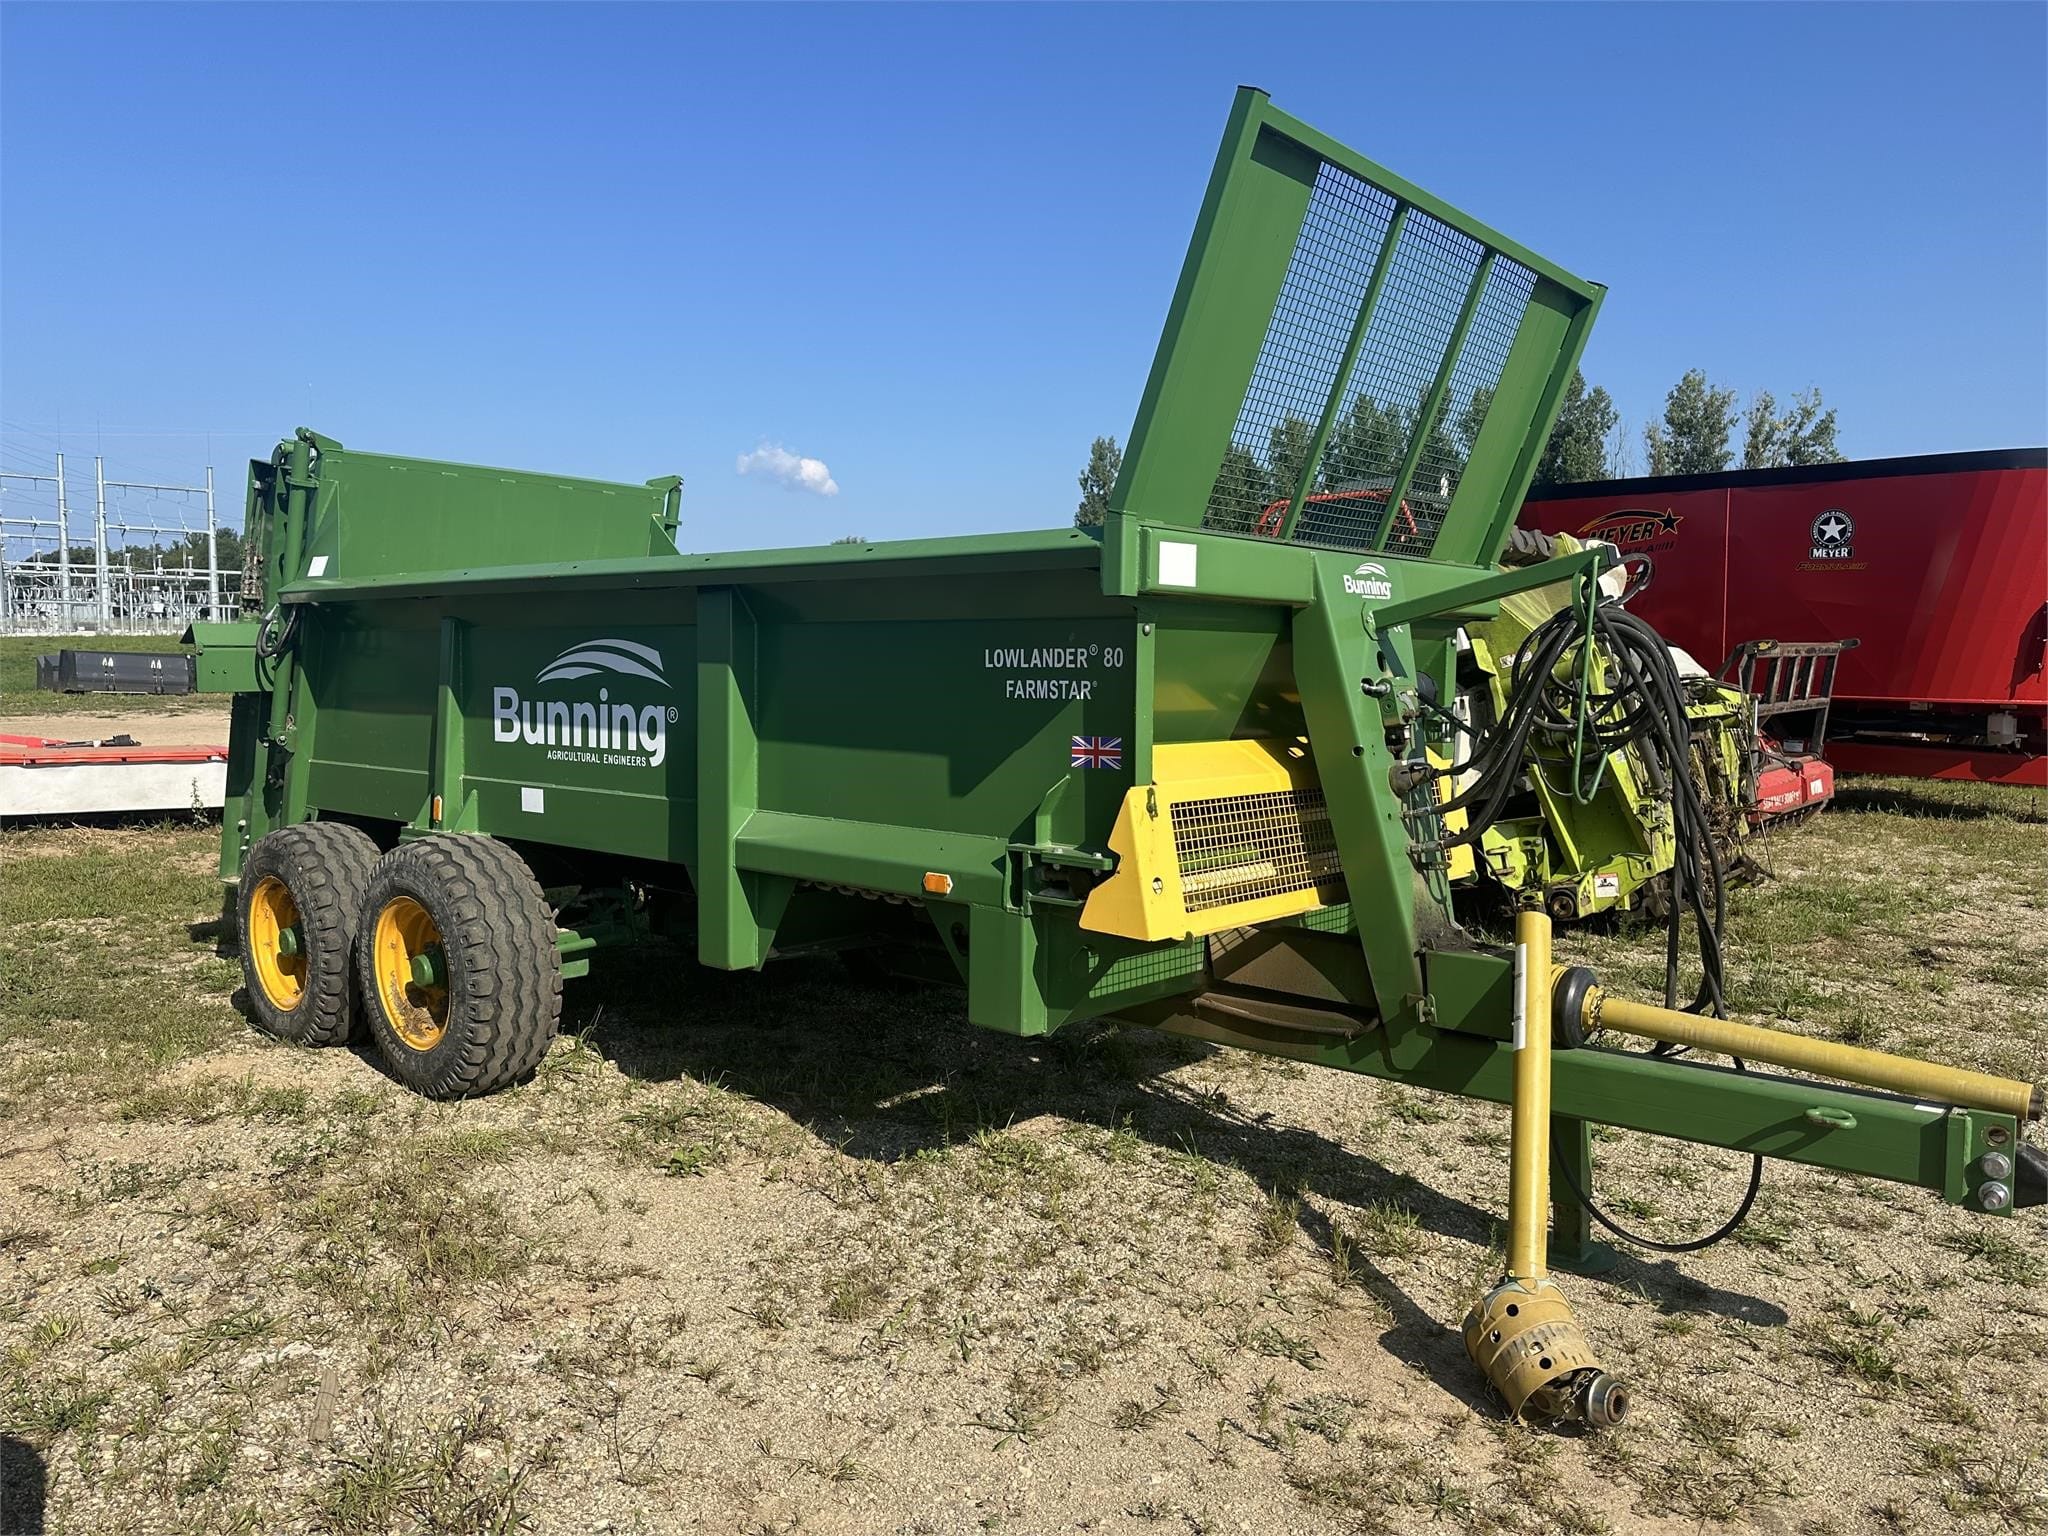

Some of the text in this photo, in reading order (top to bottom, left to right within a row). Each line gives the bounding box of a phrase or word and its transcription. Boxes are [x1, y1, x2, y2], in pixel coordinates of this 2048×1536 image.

[1812, 547, 1849, 558] MEYER
[1343, 574, 1392, 599] Bunning
[1103, 647, 1124, 668] 80
[547, 750, 647, 767] AGRICULTURAL ENGINEERS
